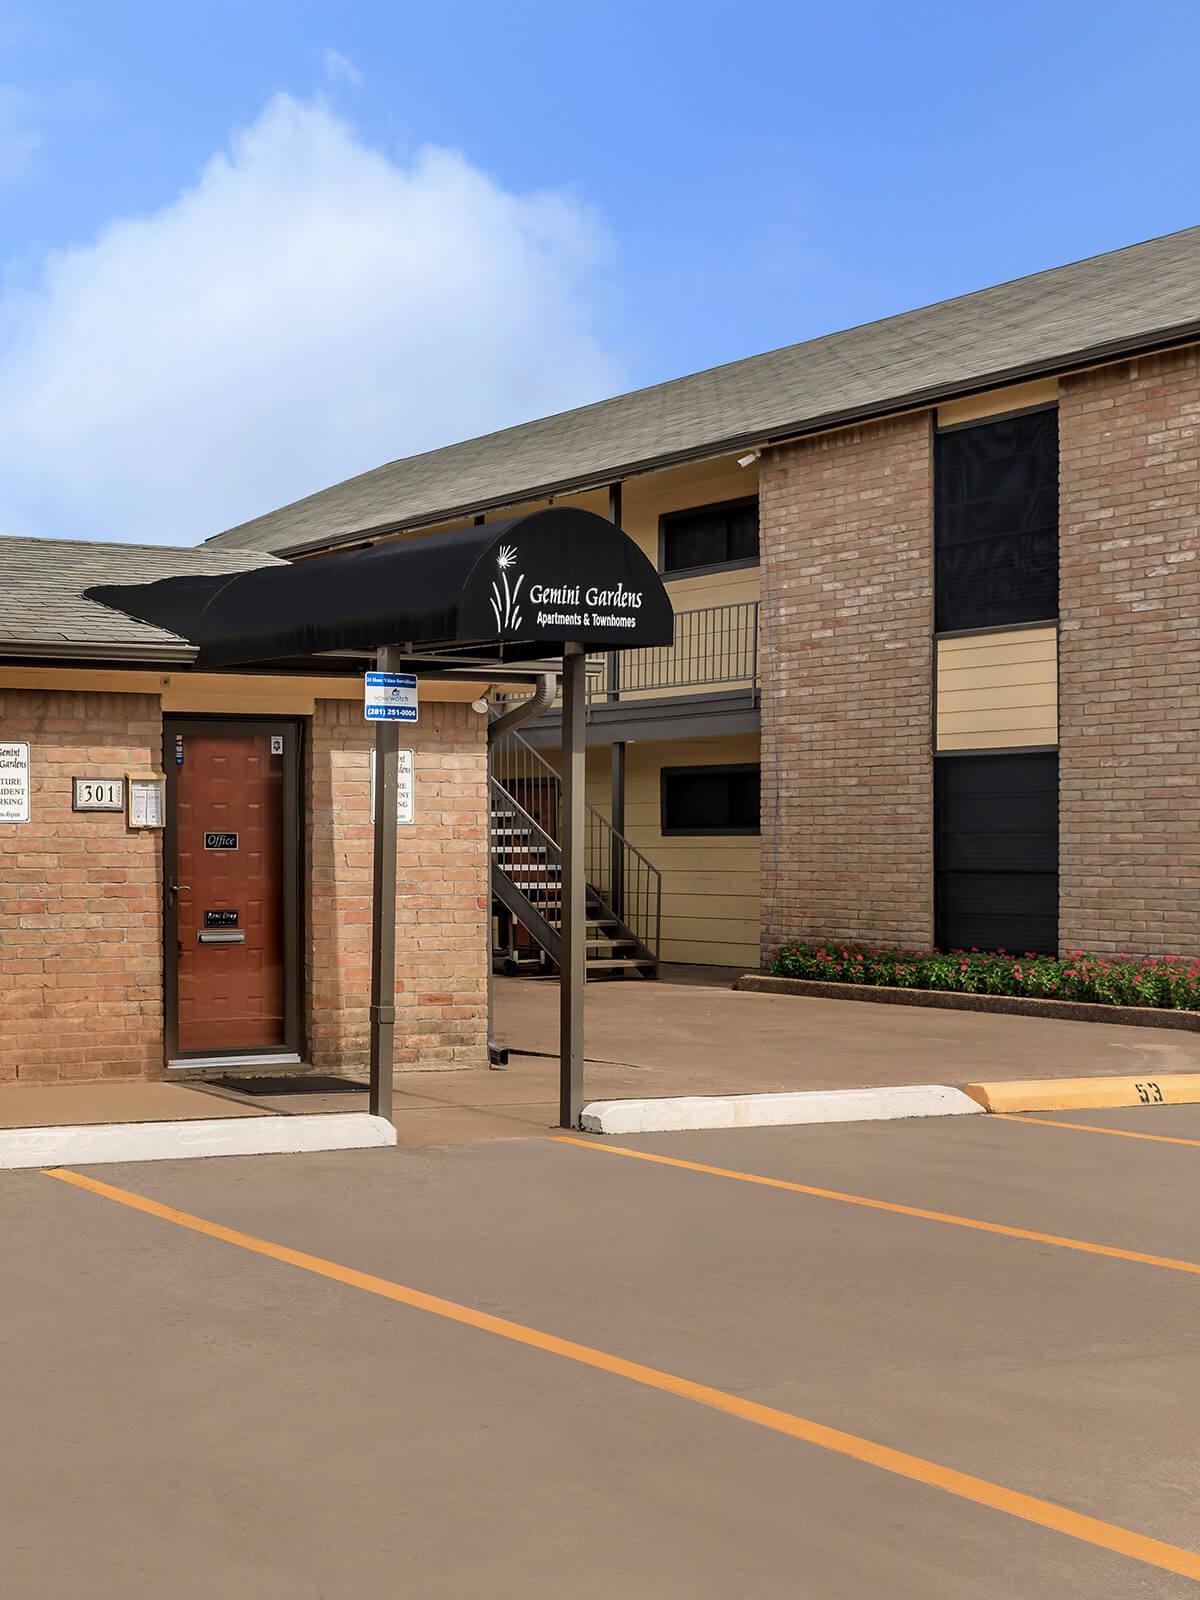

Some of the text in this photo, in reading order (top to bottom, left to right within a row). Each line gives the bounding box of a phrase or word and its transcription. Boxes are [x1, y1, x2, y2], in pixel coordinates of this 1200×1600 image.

[529, 582, 643, 608] Gemini Gardens
[536, 611, 636, 628] Apartments & Townhomes
[367, 708, 416, 717] (281) 251-0004
[0, 758, 27, 769] Gardens
[84, 785, 114, 802] 301
[207, 834, 236, 848] Office
[1135, 1082, 1164, 1104] 53
